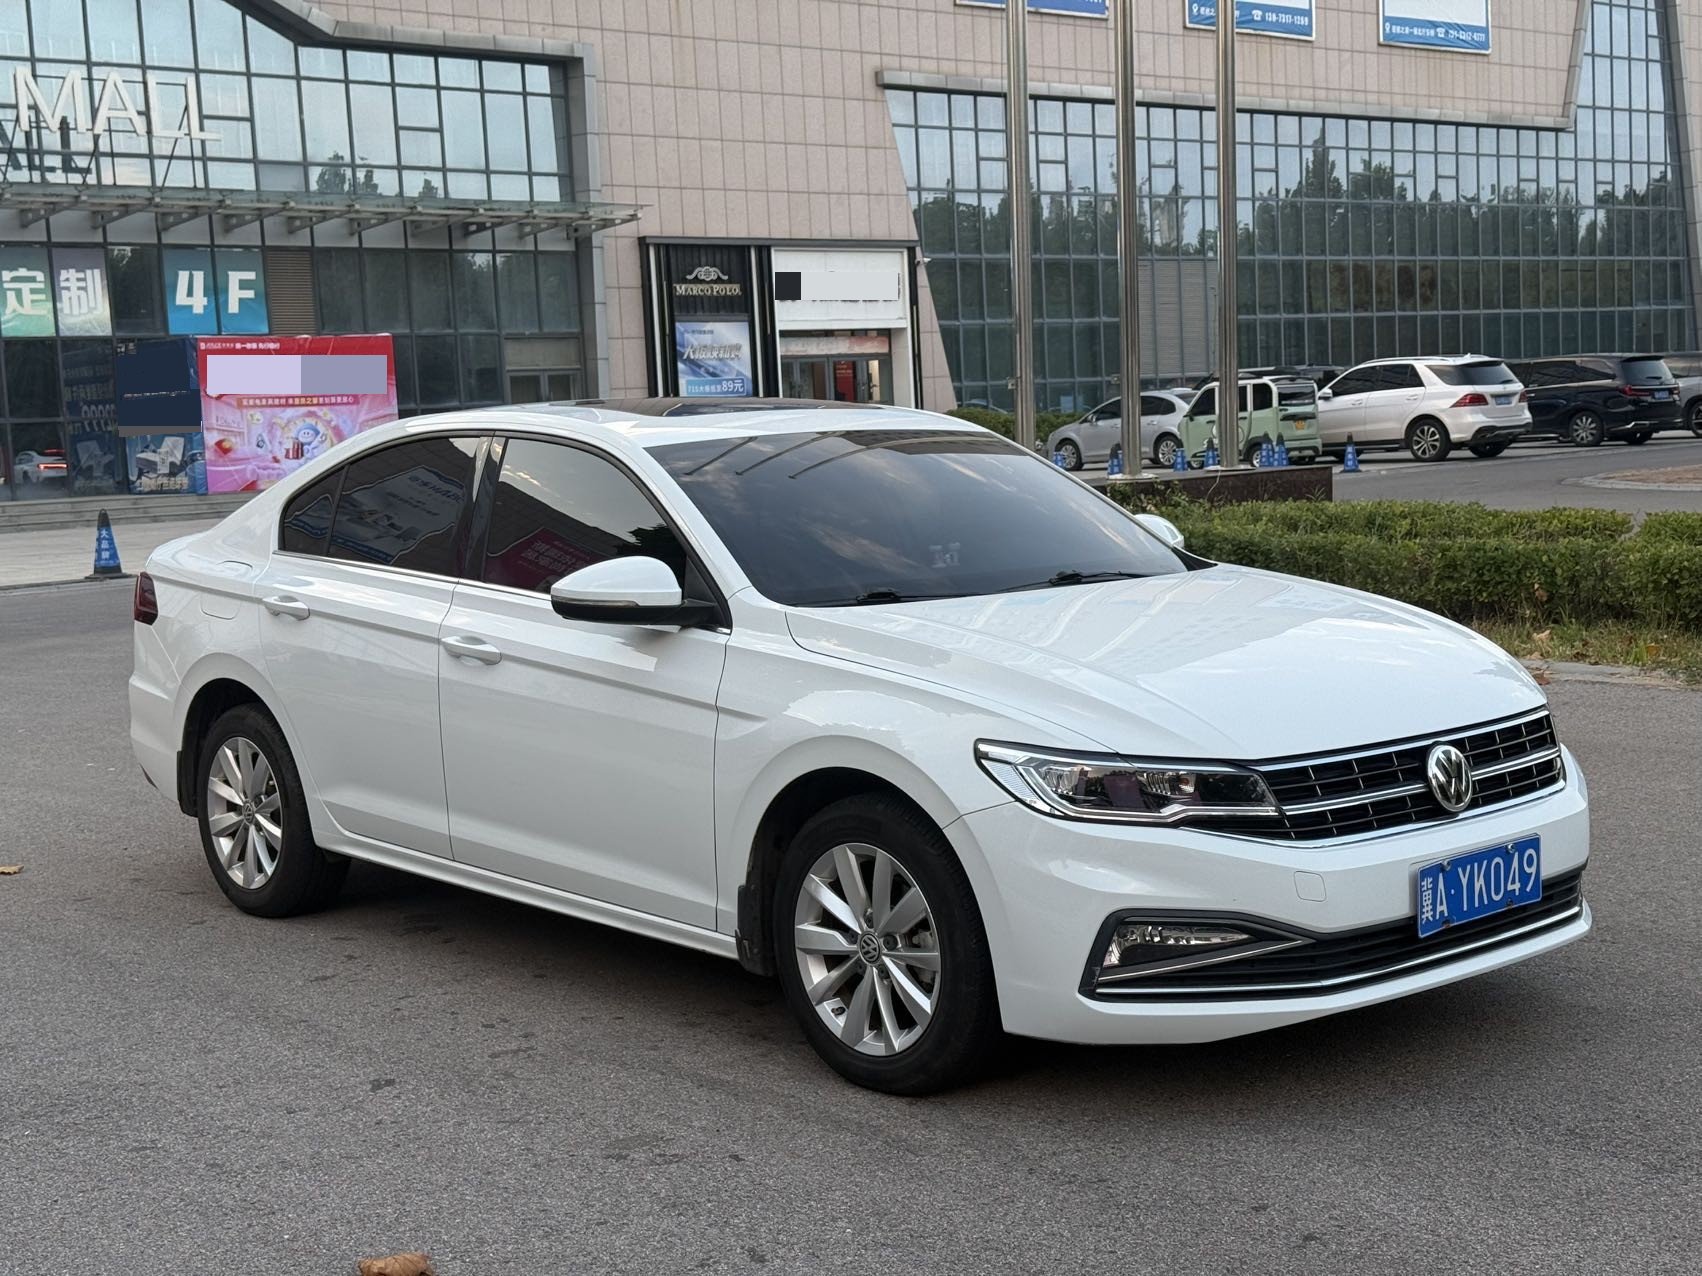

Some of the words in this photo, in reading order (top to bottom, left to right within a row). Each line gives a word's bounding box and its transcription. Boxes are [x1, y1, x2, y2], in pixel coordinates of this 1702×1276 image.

[14, 66, 223, 141] MALL
[1, 268, 104, 316] 定制
[175, 270, 257, 314] 4F
[676, 284, 711, 296] MARCO
